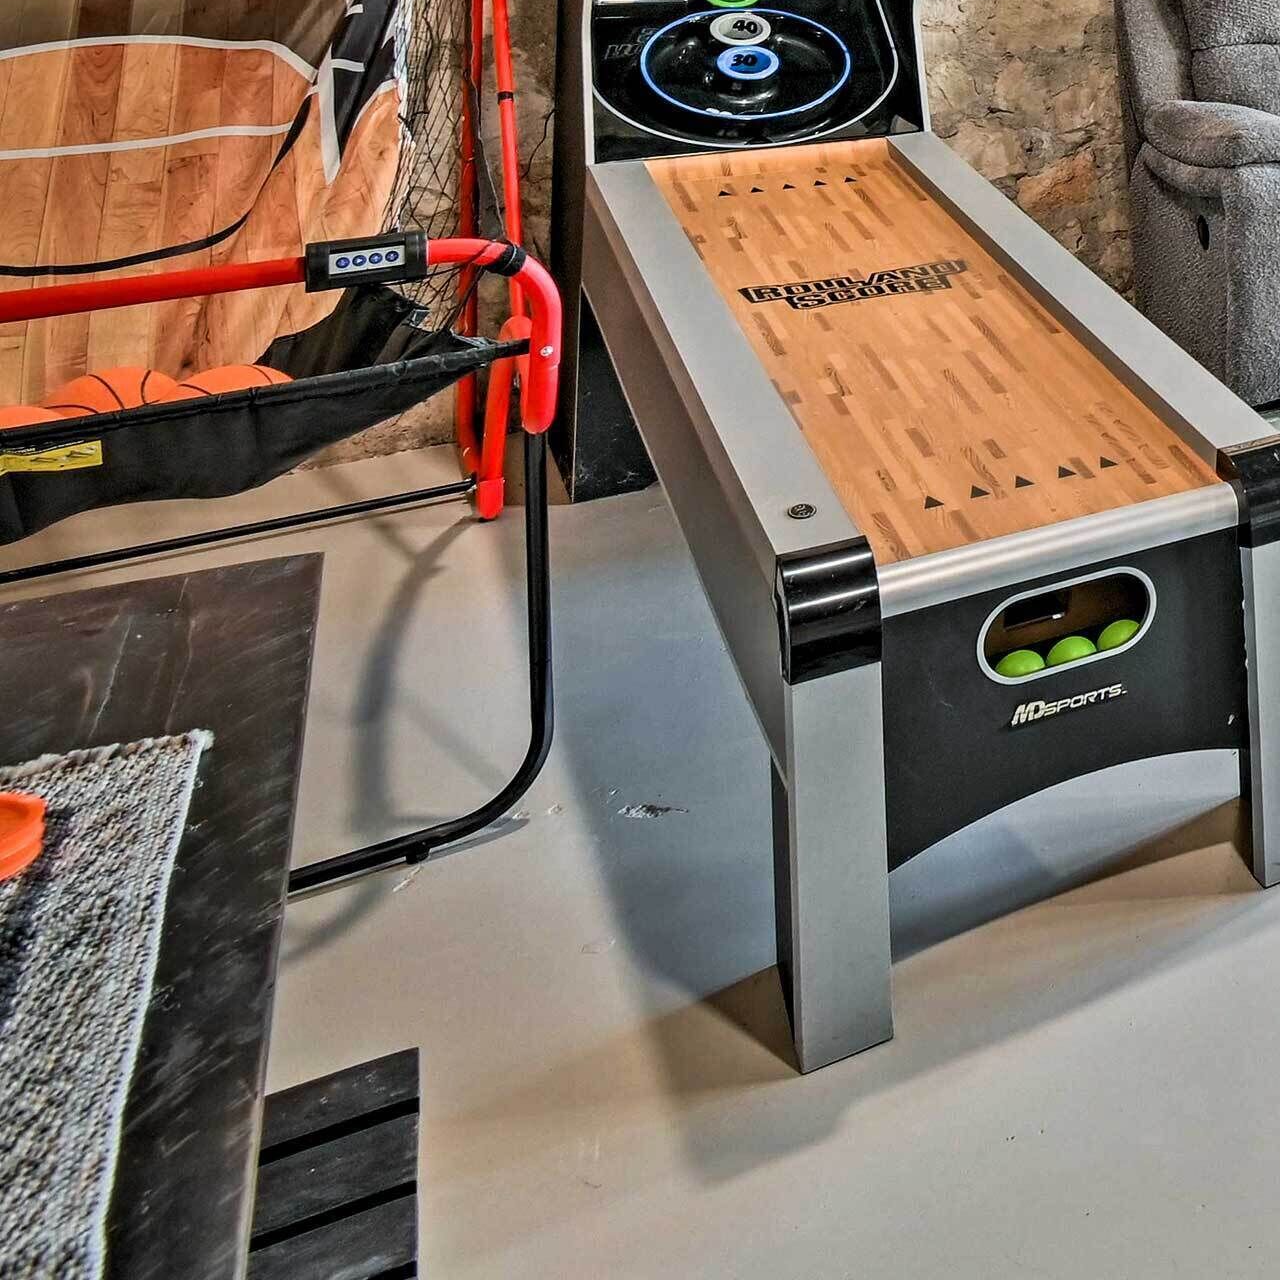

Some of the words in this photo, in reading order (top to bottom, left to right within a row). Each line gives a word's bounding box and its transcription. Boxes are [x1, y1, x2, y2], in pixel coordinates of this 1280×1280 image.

[732, 19, 758, 34] 40
[731, 53, 757, 67] 30
[751, 275, 866, 303] ROLL
[868, 260, 963, 286] AND
[793, 276, 947, 310] SCORE
